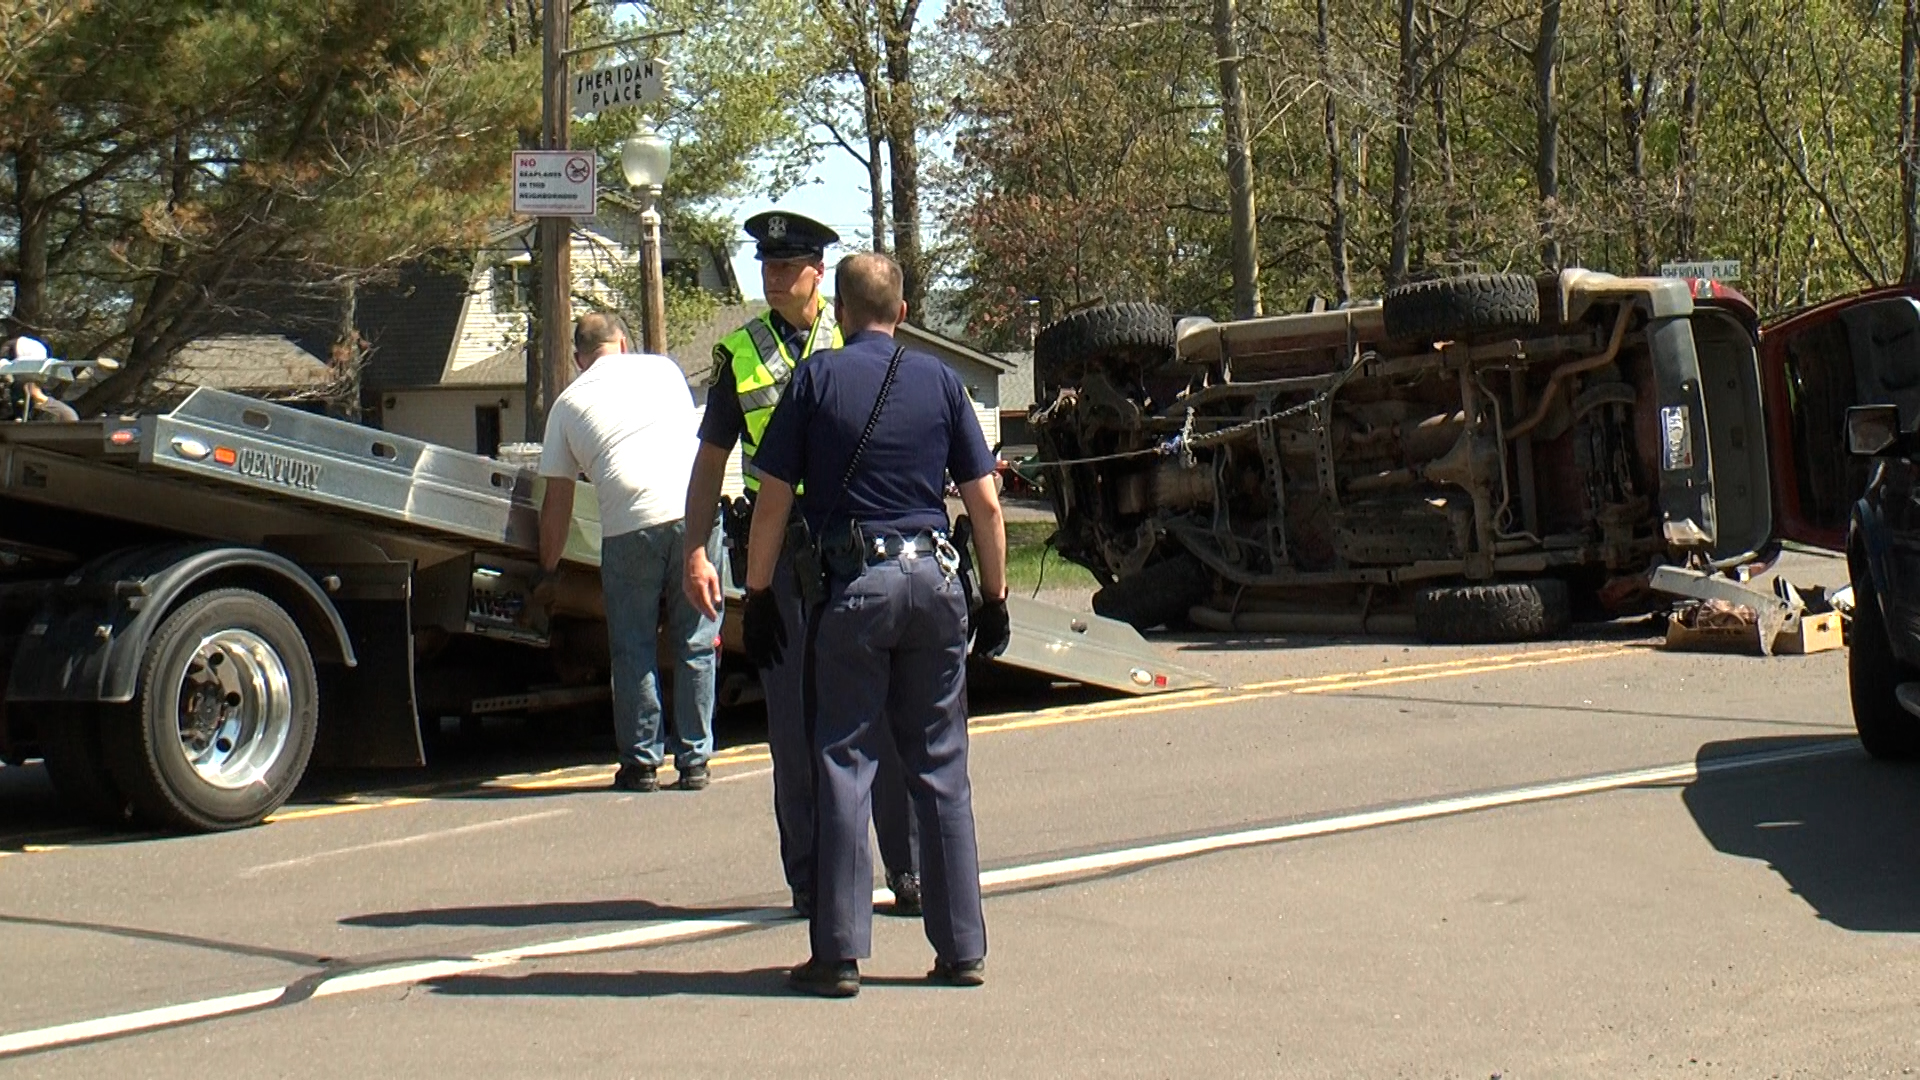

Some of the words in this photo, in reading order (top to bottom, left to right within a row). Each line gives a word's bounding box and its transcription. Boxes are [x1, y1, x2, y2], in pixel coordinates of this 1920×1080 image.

[576, 62, 654, 95] SHERIDAN
[592, 84, 643, 109] PLACE
[519, 158, 537, 168] NO
[519, 192, 579, 200] NEIGHBORHOOD
[1662, 265, 1705, 279] SHERIDAN
[1711, 264, 1740, 277] PLACE
[239, 447, 322, 490] CENTURY
